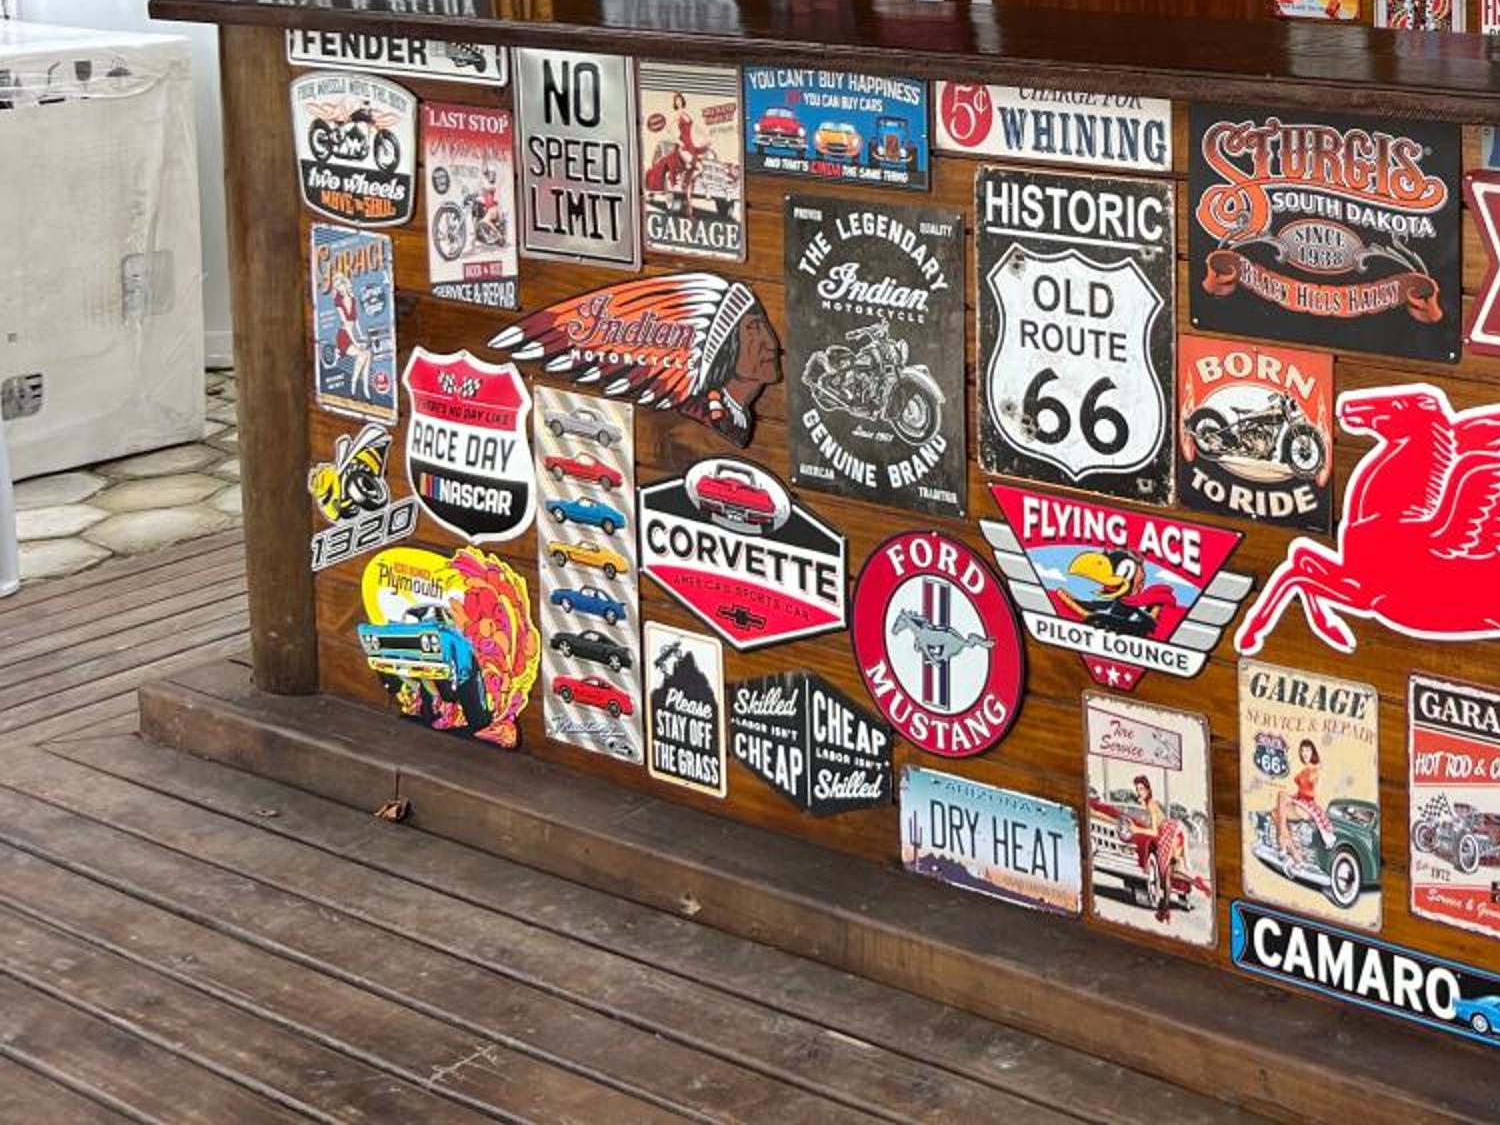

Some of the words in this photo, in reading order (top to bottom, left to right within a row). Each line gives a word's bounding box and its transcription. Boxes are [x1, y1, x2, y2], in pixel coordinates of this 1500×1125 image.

[543, 60, 600, 127] NO
[529, 138, 621, 185] SPEED
[998, 108, 1167, 165] WHINING
[532, 186, 622, 241] LIMIT
[648, 216, 740, 250] GARAGE
[985, 181, 1163, 240] HISTORIC
[1033, 276, 1114, 319] OLD
[1020, 322, 1127, 363] ROUTE
[1023, 368, 1130, 455] 66
[413, 425, 460, 462] RACE
[466, 429, 515, 469] DAY
[439, 475, 513, 515] NASCAR
[646, 519, 839, 602] CORVETTE
[1022, 502, 1128, 547] FLYING
[1138, 524, 1201, 573] ACE
[1036, 620, 1097, 649] PILOT
[1102, 631, 1189, 672] LOUNGE
[656, 711, 688, 739] STAY
[692, 719, 712, 744] OFF
[666, 688, 711, 717] Please
[654, 739, 676, 768] THE
[677, 745, 718, 784] GRASS
[930, 799, 979, 857] DRY
[993, 813, 1061, 882] HEAT
[1253, 918, 1460, 1019] CAMARO
